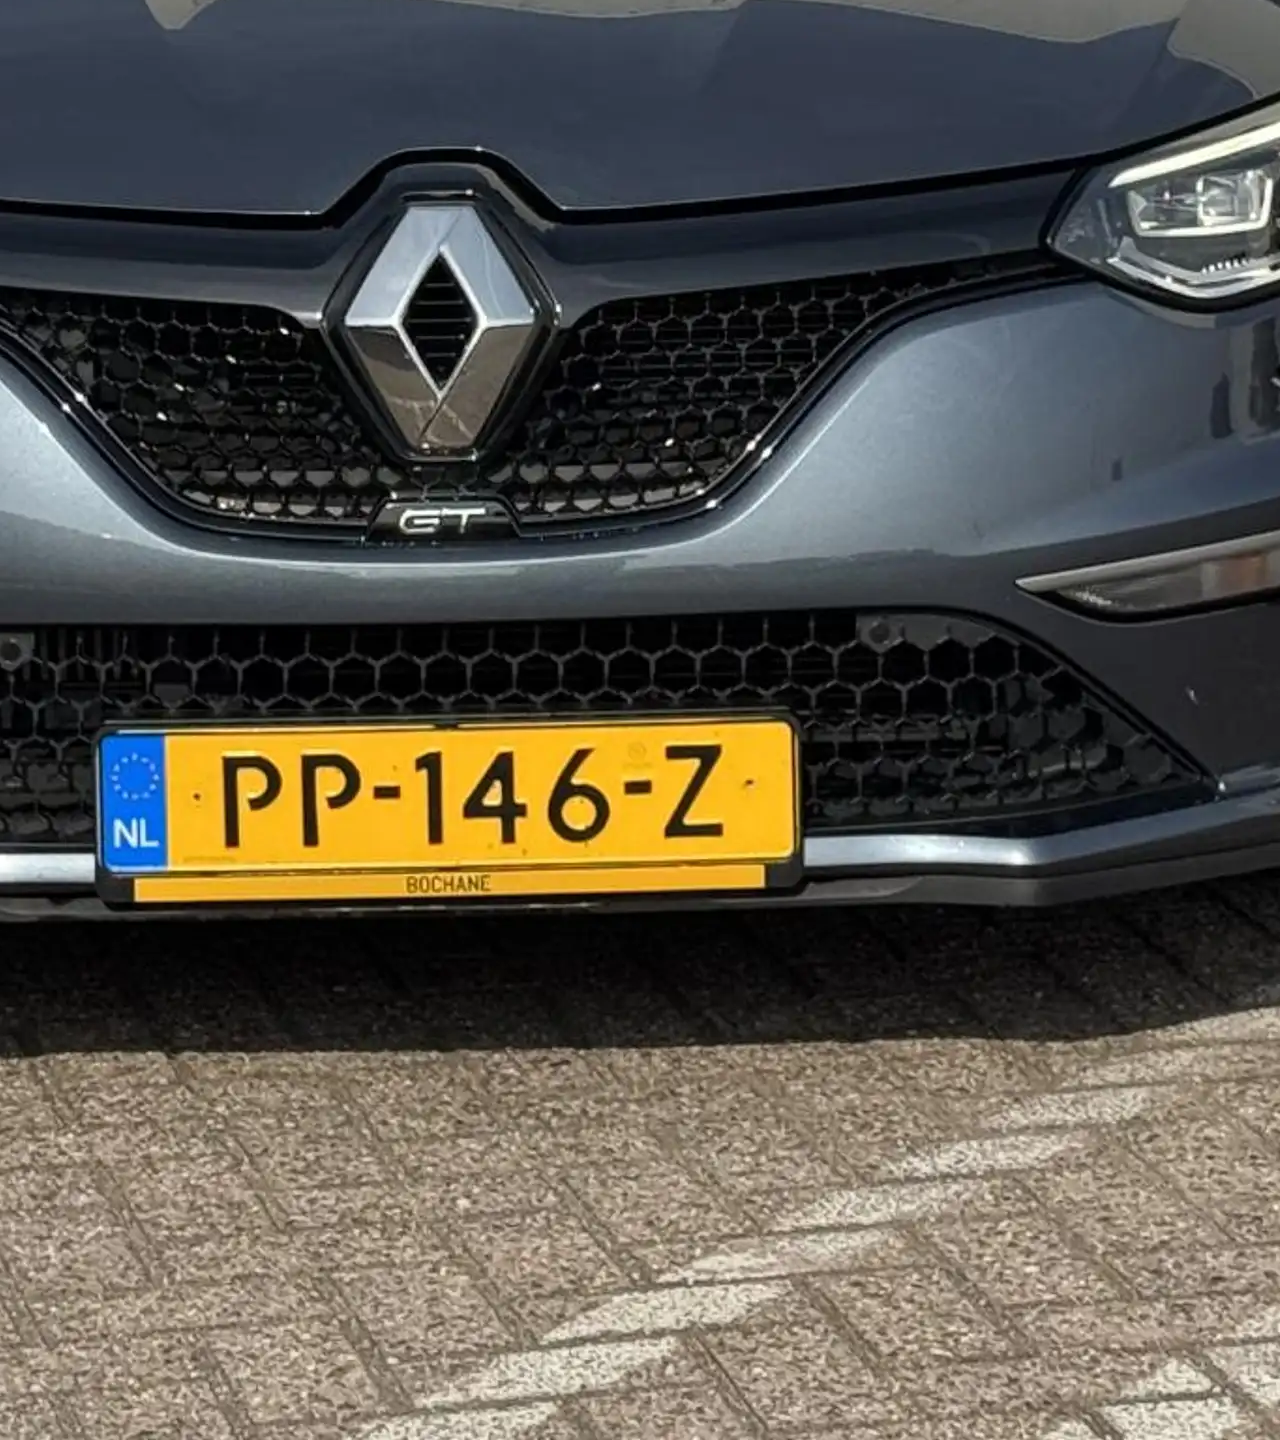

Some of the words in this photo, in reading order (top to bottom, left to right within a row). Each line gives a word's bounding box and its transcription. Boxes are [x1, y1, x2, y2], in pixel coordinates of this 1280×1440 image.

[399, 507, 487, 535] GT
[221, 743, 724, 849] PP-146-Z
[112, 816, 160, 849] NL
[406, 874, 492, 894] BOCHANE
